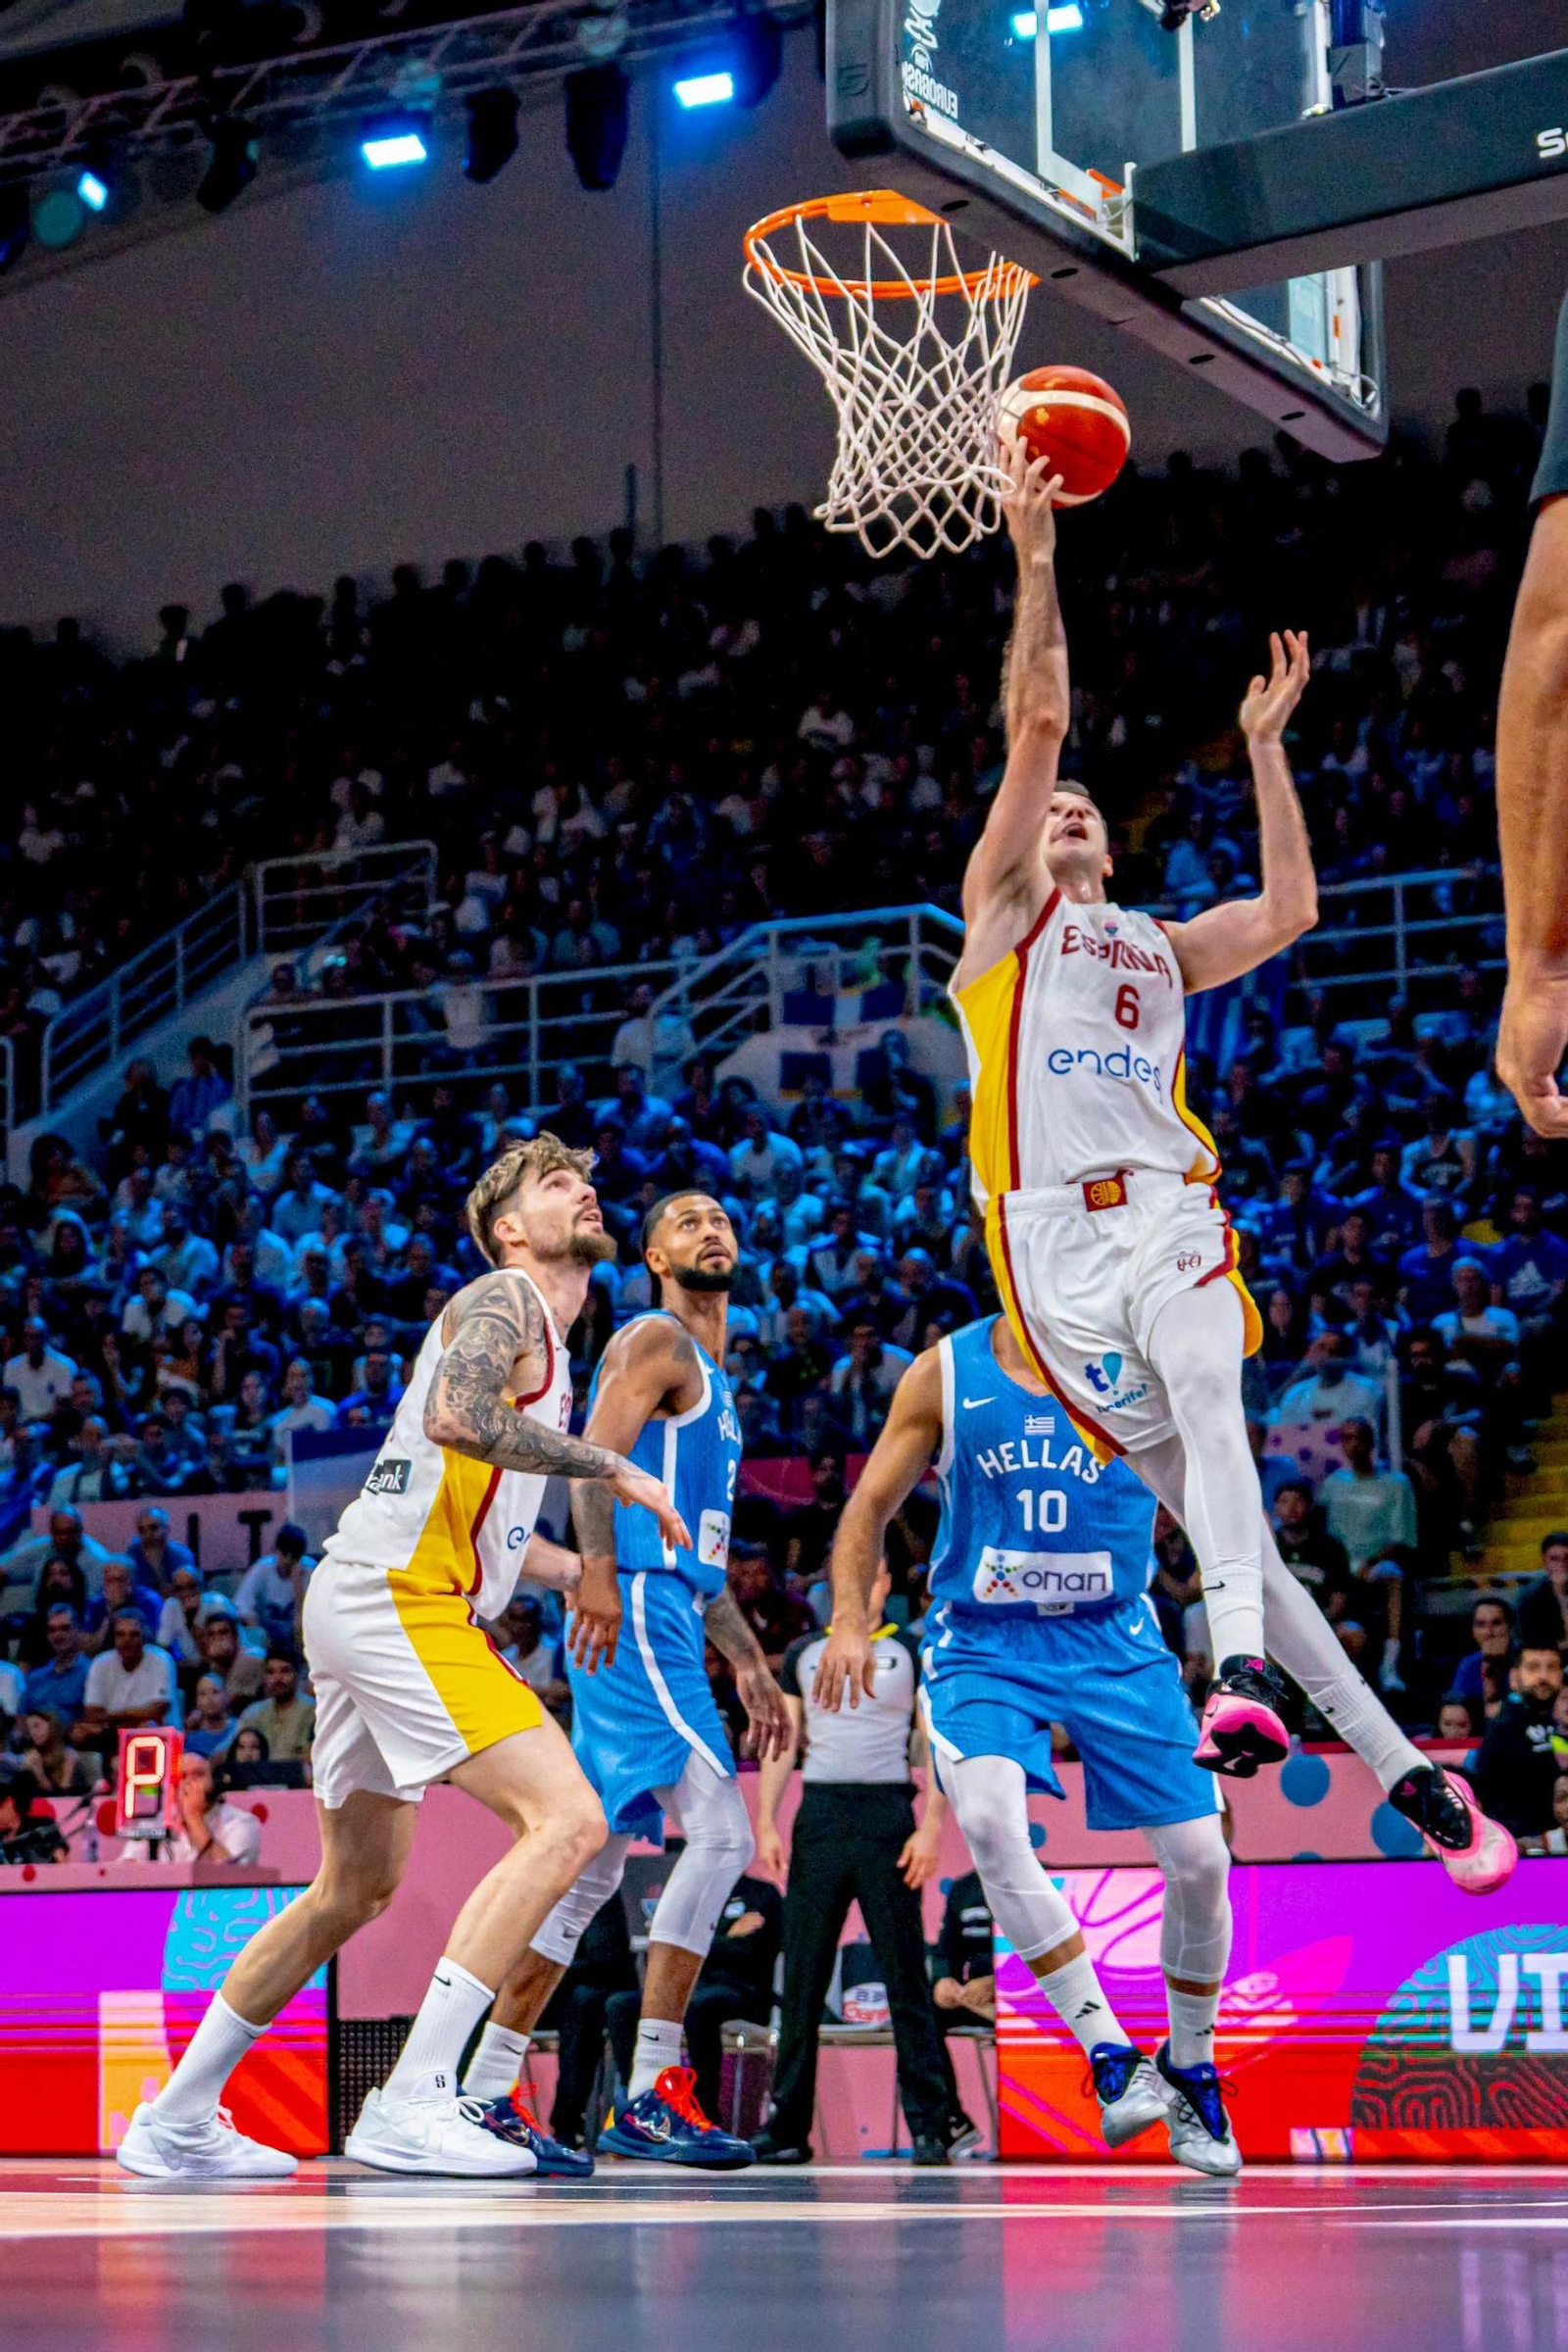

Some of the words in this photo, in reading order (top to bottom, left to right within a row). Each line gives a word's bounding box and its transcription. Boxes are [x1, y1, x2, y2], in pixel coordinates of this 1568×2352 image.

[1537, 127, 1568, 158] S
[1114, 983, 1141, 1031] 6
[1048, 1044, 1162, 1093] endes
[368, 1464, 403, 1491] ank
[976, 1439, 1105, 1485] HELLAS
[1015, 1489, 1067, 1533] 10
